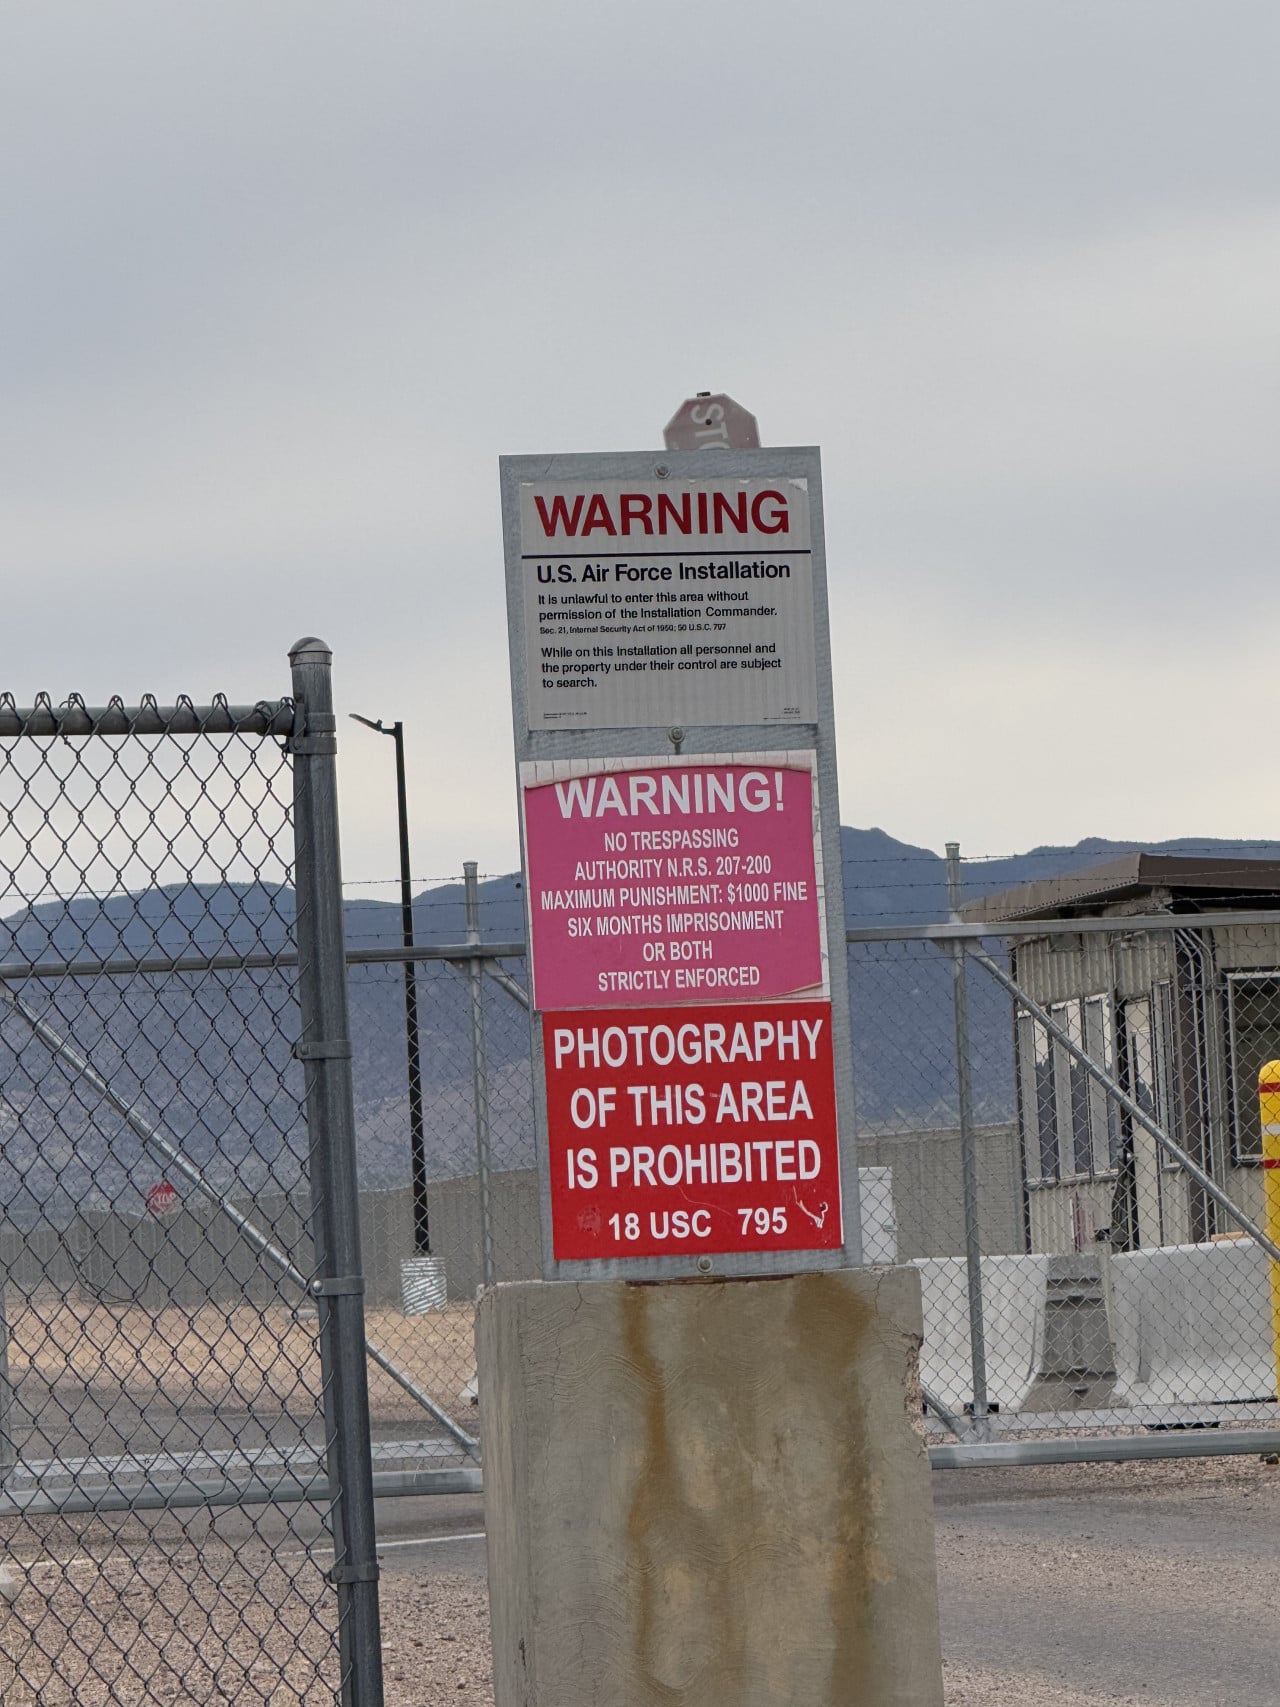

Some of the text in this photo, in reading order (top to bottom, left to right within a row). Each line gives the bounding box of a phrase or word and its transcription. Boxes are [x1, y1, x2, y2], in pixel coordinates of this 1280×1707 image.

[691, 403, 730, 449] ST
[534, 490, 789, 537] WARNING
[537, 561, 790, 583] U.S. Air Force Installation
[538, 591, 749, 604] It is unlawful to enter this area without
[539, 606, 777, 622] permission of the Installation Commander.
[570, 625, 598, 633] Internal
[600, 625, 631, 633] Security
[541, 647, 573, 658] While
[576, 647, 590, 657] on
[593, 646, 613, 656] this
[680, 644, 692, 655] all
[695, 644, 751, 656] personnel
[755, 643, 776, 653] and
[542, 658, 781, 674] the property under their control are subject
[543, 677, 597, 688] to search.
[554, 772, 784, 819] WARNING!
[604, 827, 739, 852] NO TRESPASSING
[575, 855, 771, 881] AUTHORITY N.R.S. 207-200
[541, 881, 807, 910] MAXIMUM PUNISHMENT: $1000 FINE
[567, 910, 784, 937] SIX MONTHS IMPRISONMENT
[643, 940, 713, 962] OR BOTH
[598, 966, 760, 992] STRICTLY ENFORCED
[554, 1019, 823, 1070] PHOTOGRAPHY
[570, 1079, 814, 1129] OF THIS AREA
[567, 1139, 821, 1190] IS PROHIBITED
[608, 1206, 788, 1241] 18 USC 795
